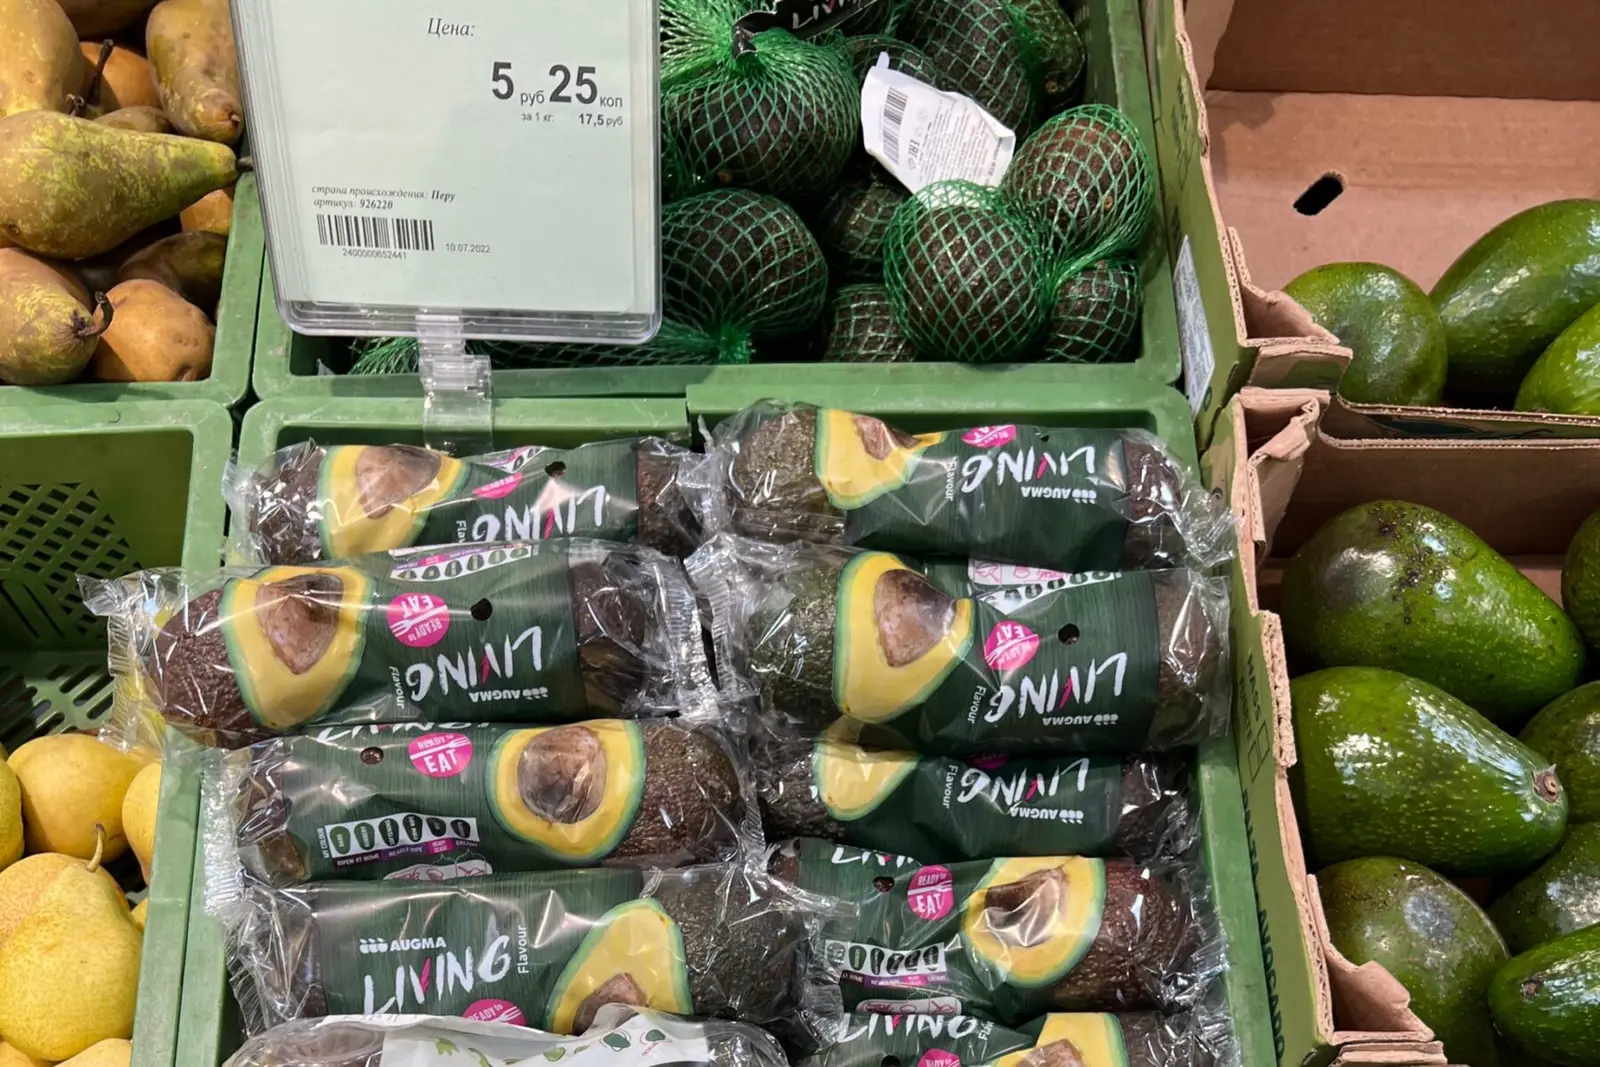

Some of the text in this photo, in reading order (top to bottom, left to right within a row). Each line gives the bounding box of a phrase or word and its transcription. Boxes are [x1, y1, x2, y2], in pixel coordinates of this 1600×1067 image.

[427, 18, 476, 38] Цена:
[491, 61, 623, 108] 5 руб 25 коп
[578, 113, 605, 127] 17,5
[606, 115, 624, 127] руб
[311, 185, 347, 196] страна
[431, 190, 456, 202] Перу
[359, 199, 393, 210] 926220
[445, 243, 491, 254] 10.07.2022
[945, 455, 959, 501] Flavour
[961, 446, 1095, 493] LIVING
[1020, 485, 1071, 499] AUGMA
[471, 485, 606, 542] LIVING
[400, 595, 435, 619] EAT
[415, 618, 442, 641] READY
[995, 624, 1026, 647] EAT
[405, 625, 542, 702] LIVING
[389, 665, 405, 710] Flavour
[469, 687, 521, 703] AUGMA
[984, 652, 1128, 723] LIVING
[967, 684, 987, 725] Flavour
[1042, 713, 1091, 726] AUGMA
[423, 749, 458, 774] EAT
[942, 764, 959, 809] Flavour
[956, 757, 1090, 803] LIVING
[1010, 806, 1060, 821] AUGMA
[918, 873, 939, 886] READY
[916, 893, 942, 914] EAT
[390, 936, 447, 951] AUGMA
[517, 925, 529, 974] Flavour
[363, 935, 511, 1016] LIVING
